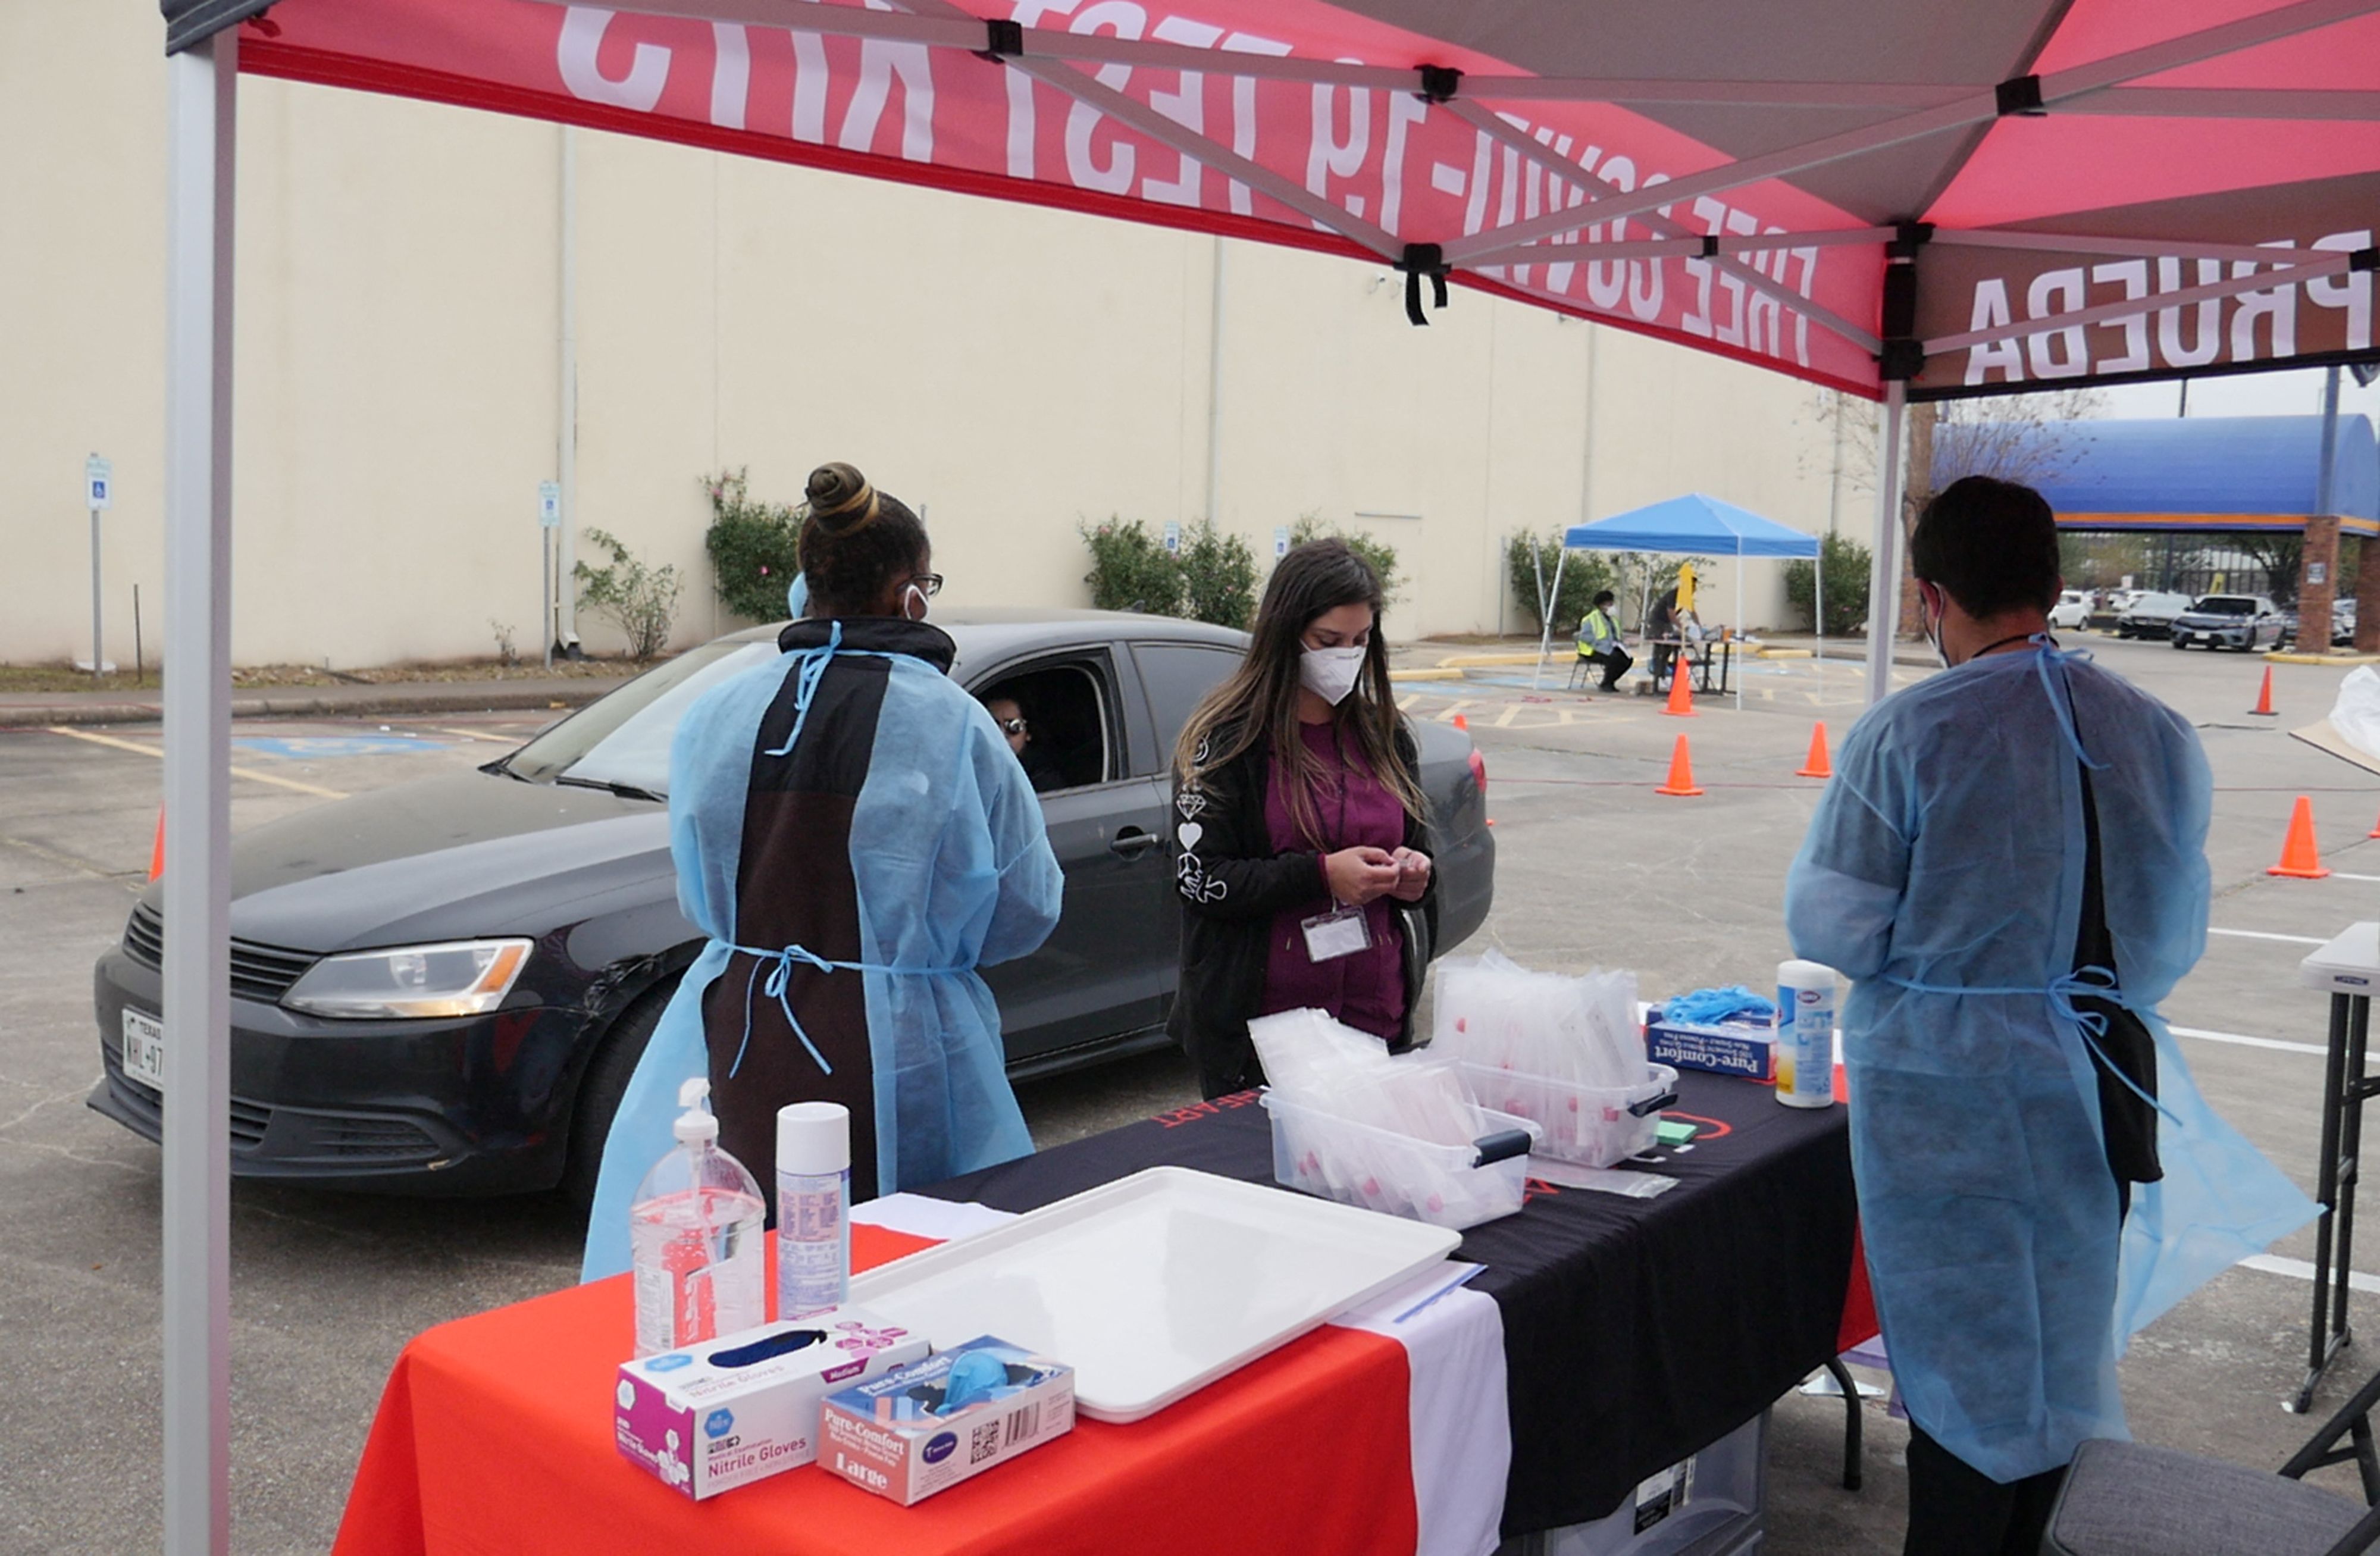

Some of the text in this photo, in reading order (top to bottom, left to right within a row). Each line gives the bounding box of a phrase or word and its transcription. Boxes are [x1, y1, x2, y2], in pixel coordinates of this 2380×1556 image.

[1655, 1045, 1758, 1073] Pure-Comfort
[825, 1407, 904, 1455] Pure-Comfort
[709, 1454, 756, 1478] Nitrile
[759, 1438, 807, 1461] Gloves
[836, 1452, 888, 1489] Large
